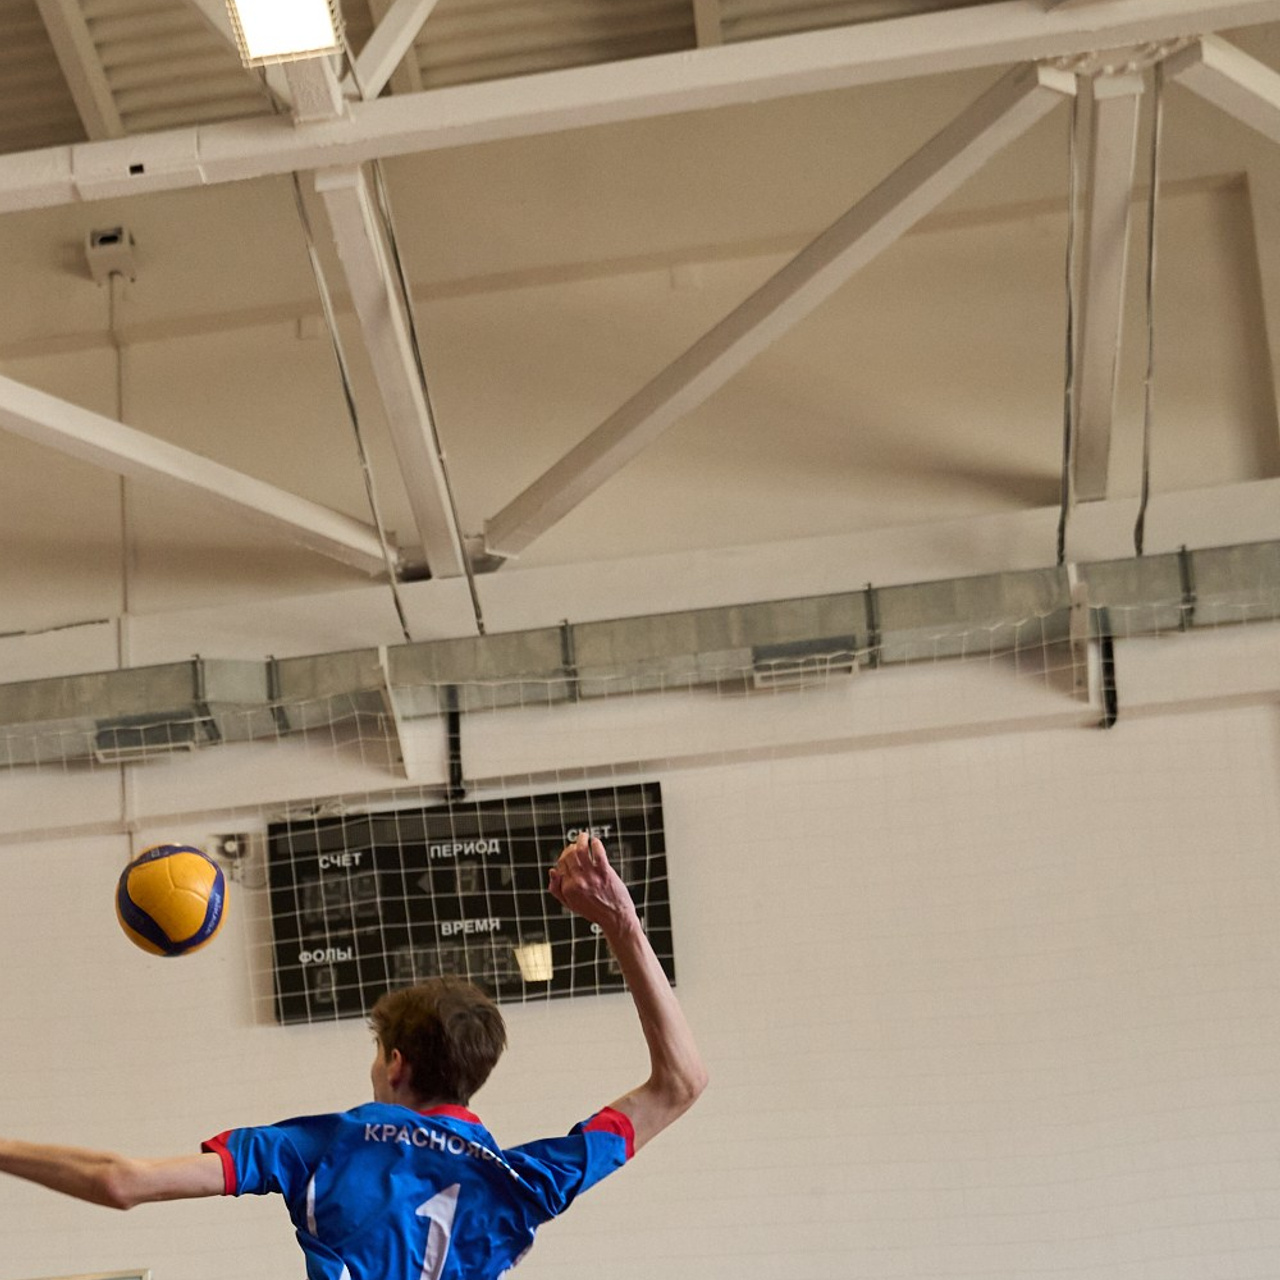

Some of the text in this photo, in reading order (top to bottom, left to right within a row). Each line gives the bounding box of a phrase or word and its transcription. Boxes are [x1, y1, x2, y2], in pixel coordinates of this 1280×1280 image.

[430, 838, 500, 859] ПЕРИОД
[320, 852, 362, 869] СЧЕТ
[441, 917, 500, 936] ВРЕМЯ
[298, 946, 352, 963] ФОЛЫ
